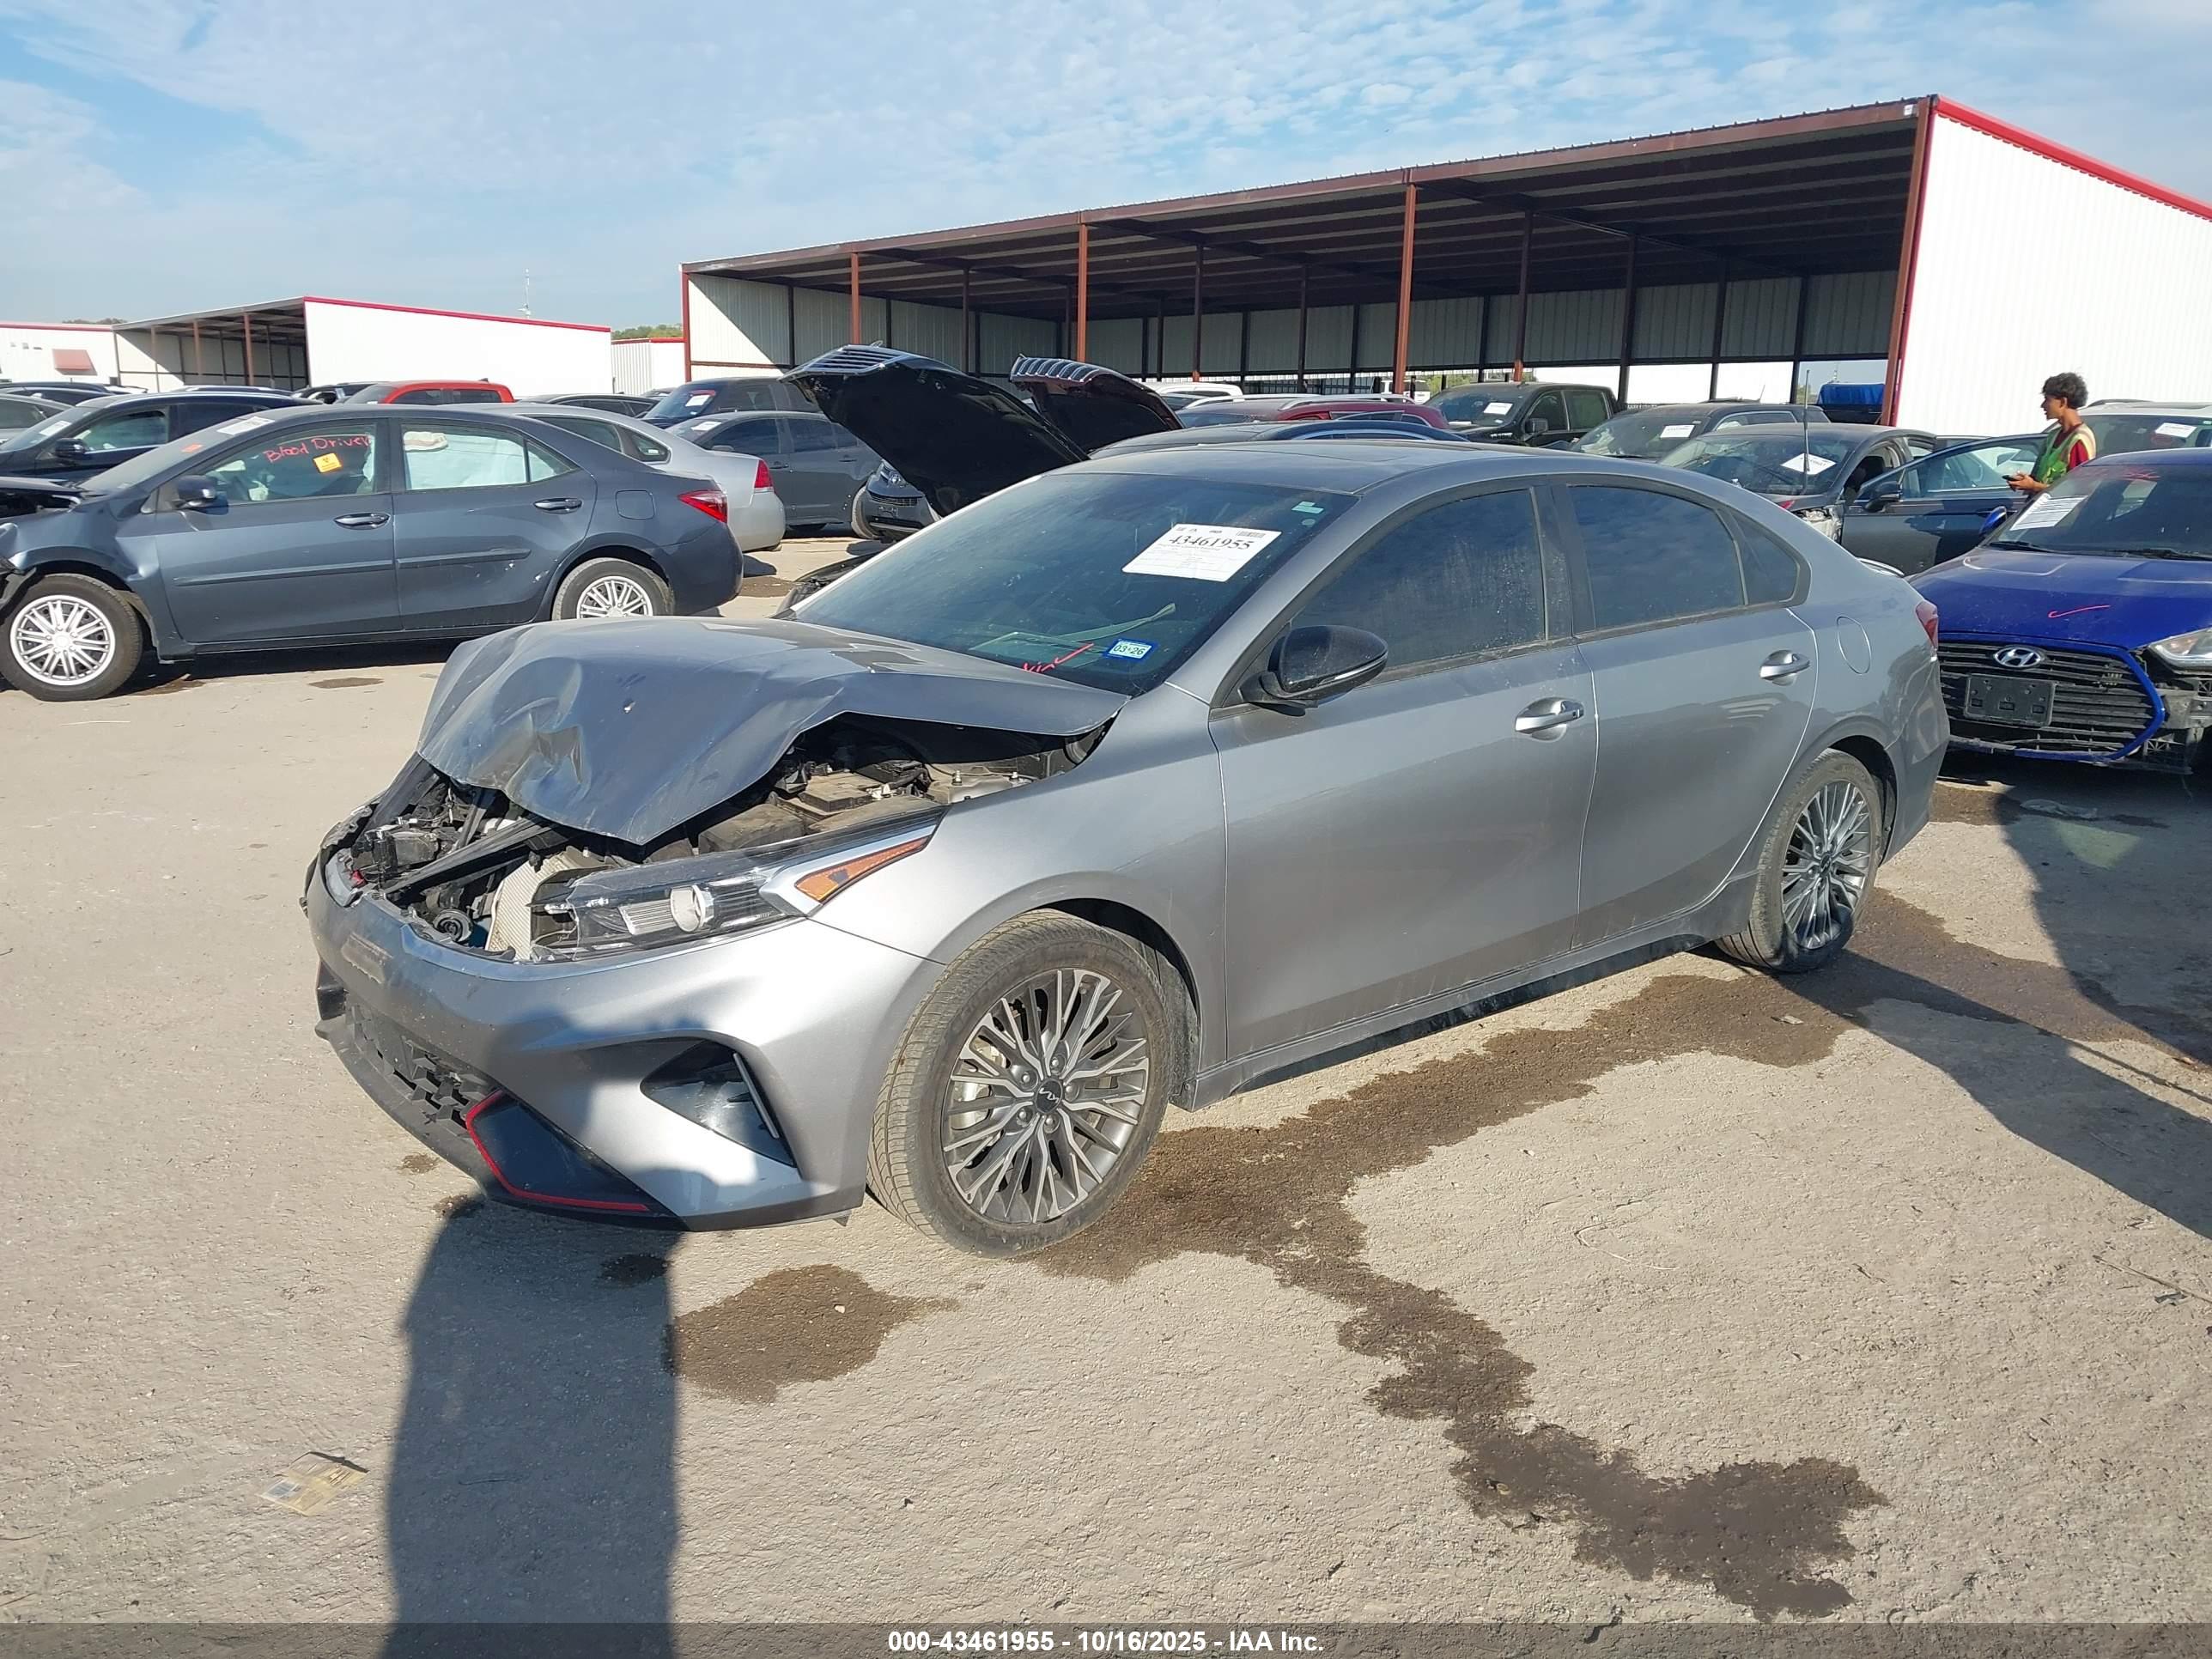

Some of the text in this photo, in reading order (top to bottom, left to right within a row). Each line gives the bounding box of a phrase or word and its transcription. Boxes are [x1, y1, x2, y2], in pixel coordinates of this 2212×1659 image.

[262, 442, 309, 463] Blood
[1169, 534, 1255, 550] 43461955
[1129, 647, 1146, 655] 26
